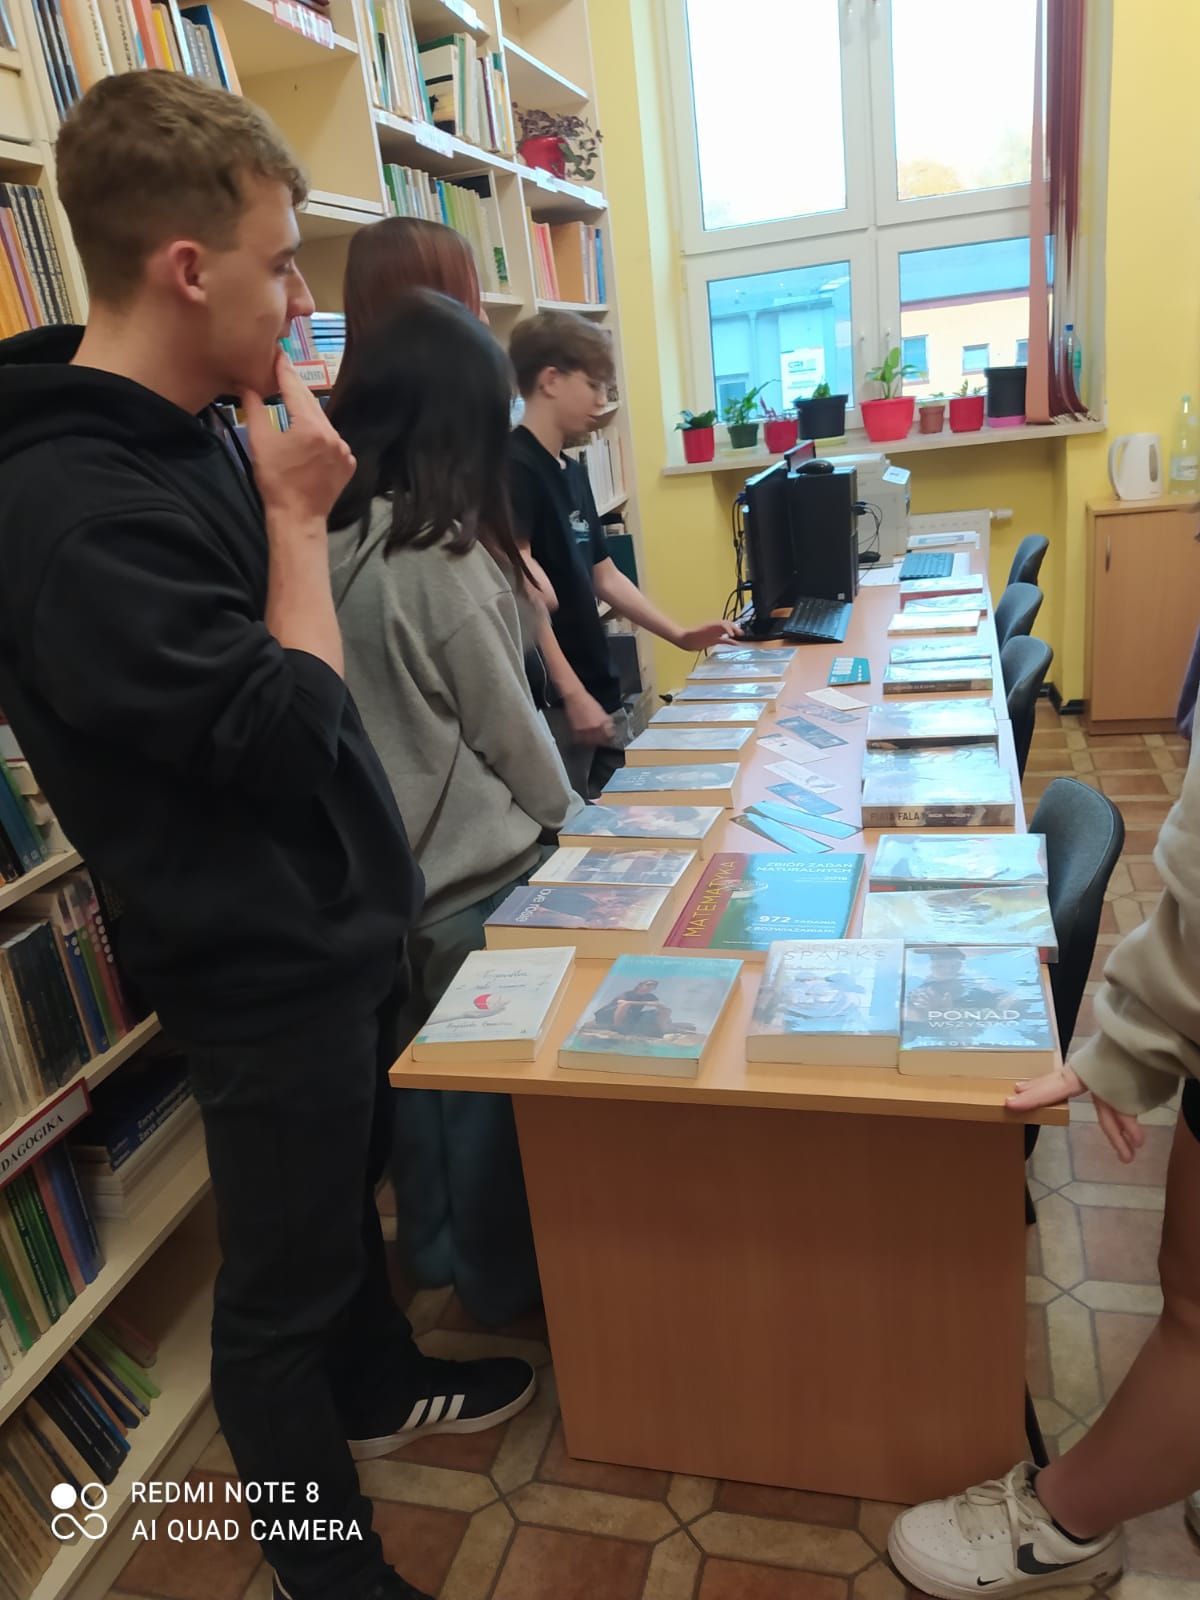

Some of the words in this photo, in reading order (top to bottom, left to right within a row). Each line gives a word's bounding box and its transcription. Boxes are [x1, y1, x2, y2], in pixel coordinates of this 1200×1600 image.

[898, 812, 920, 821] FALA
[683, 861, 737, 938] MATEMATYKA
[759, 915, 791, 923] 972
[783, 950, 888, 961] SPARKS
[928, 1010, 1020, 1020] PONAD
[0, 1115, 64, 1173] DAGOGIKA
